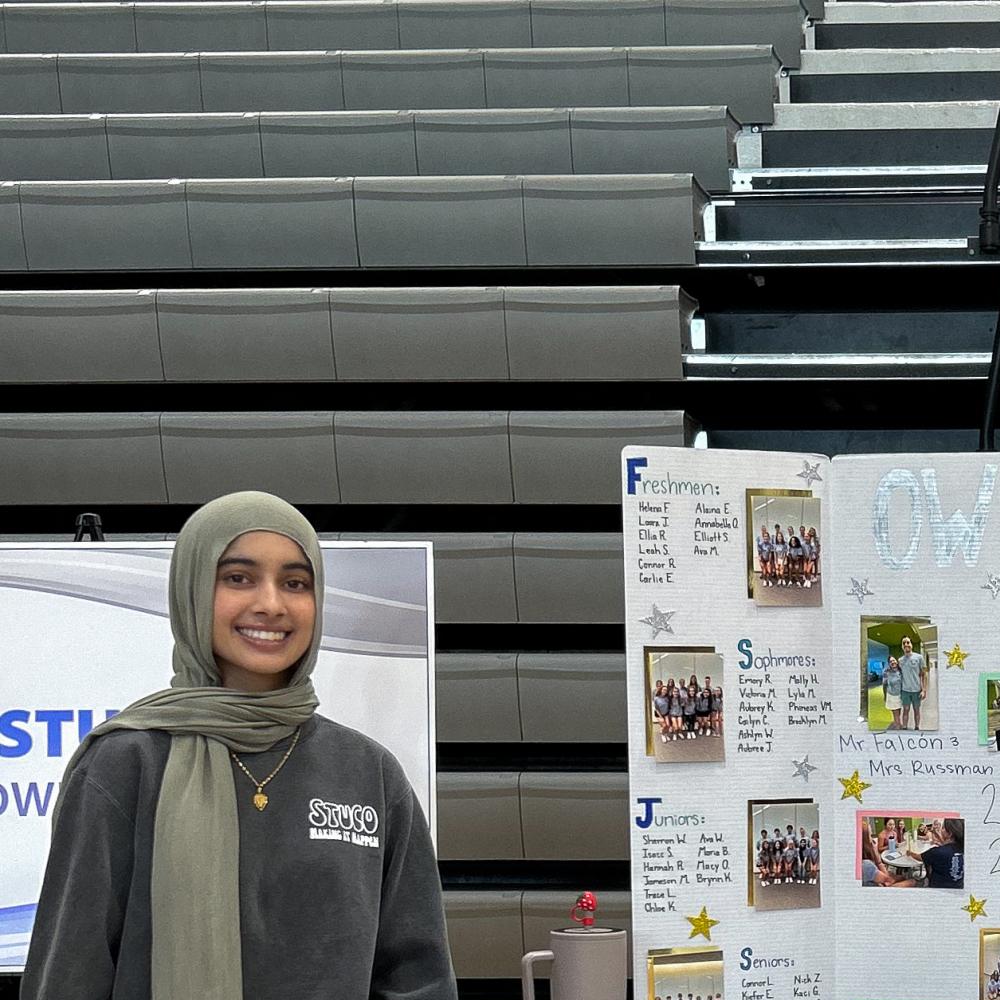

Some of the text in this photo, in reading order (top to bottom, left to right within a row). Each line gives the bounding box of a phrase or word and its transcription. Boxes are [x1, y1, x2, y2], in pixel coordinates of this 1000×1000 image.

[626, 457, 720, 496] Freshmen:
[873, 463, 999, 570] OW
[638, 544, 661, 555] Leah
[737, 638, 816, 672] Sophmores:
[839, 734, 865, 753] Mr
[873, 732, 943, 753] Falcón
[869, 759, 994, 777] Mrs Russman
[309, 798, 379, 835] STUCO
[635, 797, 706, 829] Juniors:
[740, 947, 795, 971] Seniors:
